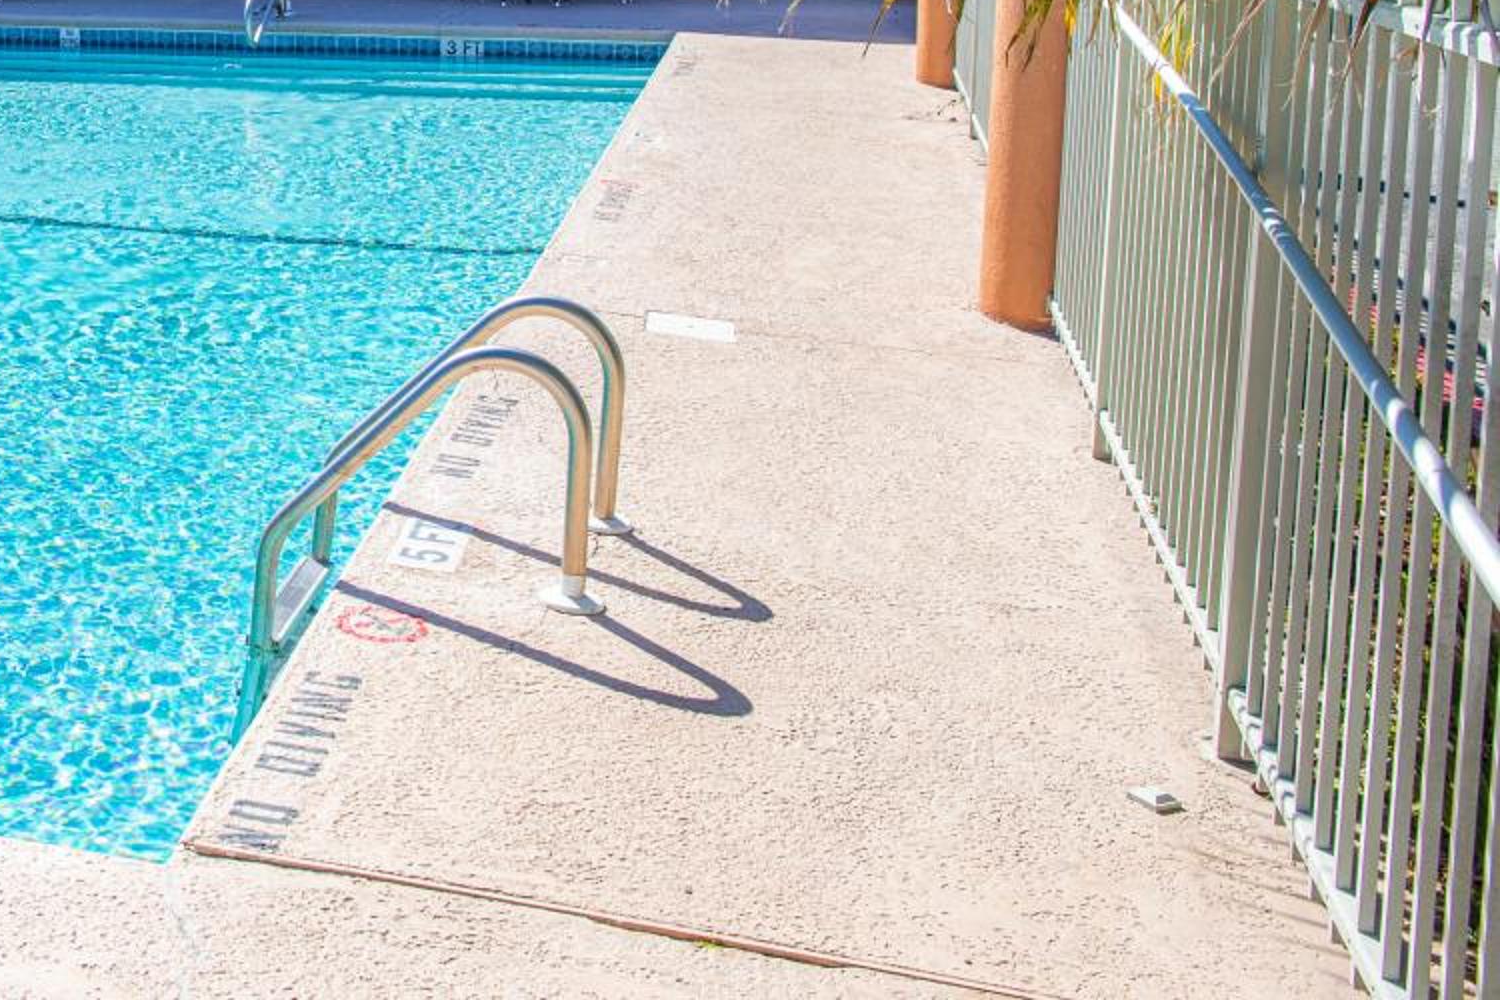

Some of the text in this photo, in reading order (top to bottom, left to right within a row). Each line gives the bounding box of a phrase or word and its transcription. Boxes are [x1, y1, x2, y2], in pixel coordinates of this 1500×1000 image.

[447, 39, 481, 55] 3 FT
[398, 546, 450, 563] 5
[218, 671, 362, 851] NO DIVING
